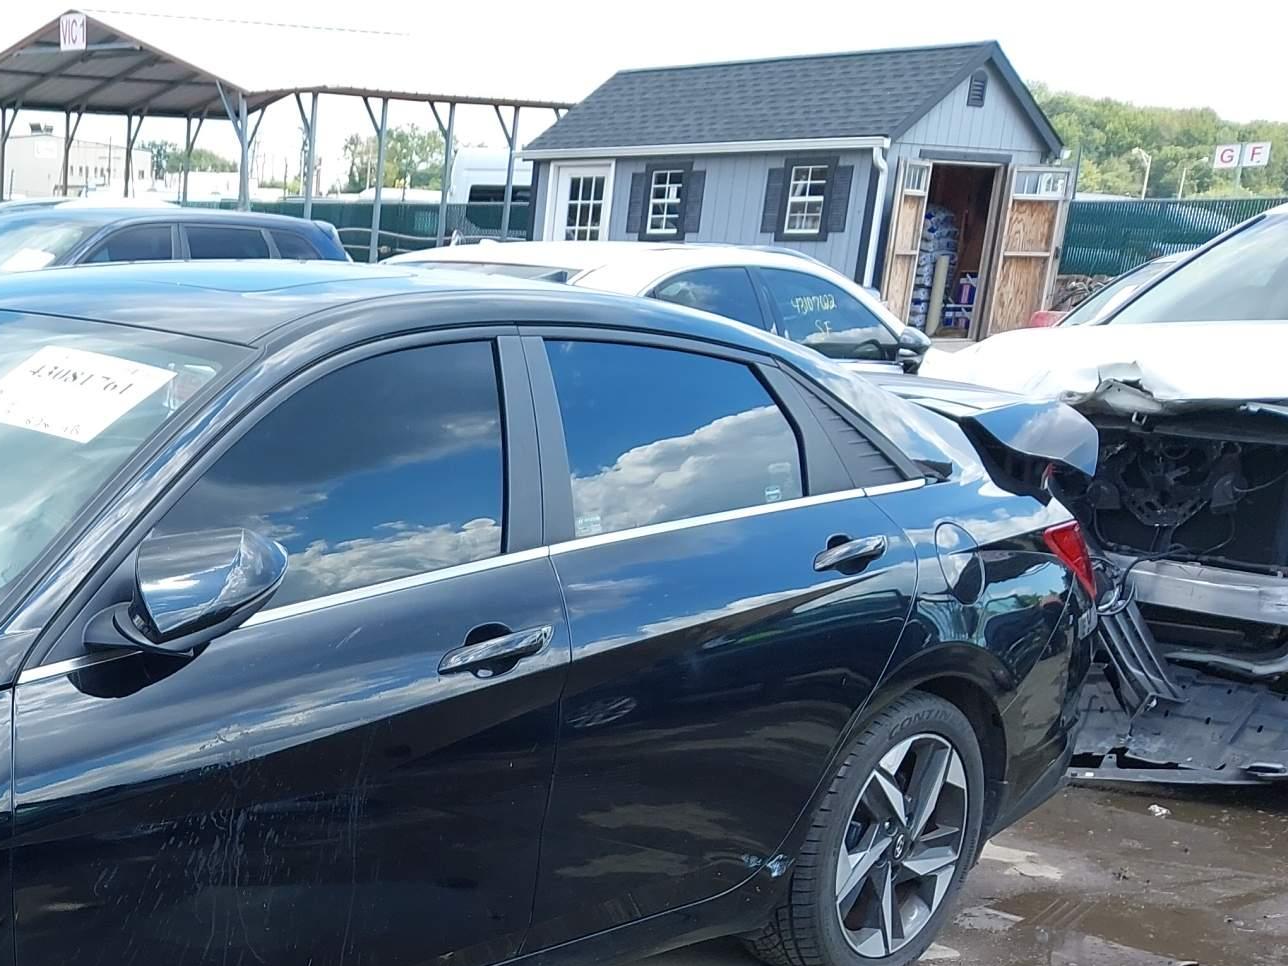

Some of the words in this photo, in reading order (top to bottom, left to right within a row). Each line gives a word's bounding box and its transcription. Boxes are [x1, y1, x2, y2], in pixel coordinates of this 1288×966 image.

[61, 19, 78, 45] VIC
[1220, 148, 1235, 164] G
[1250, 145, 1264, 161] F
